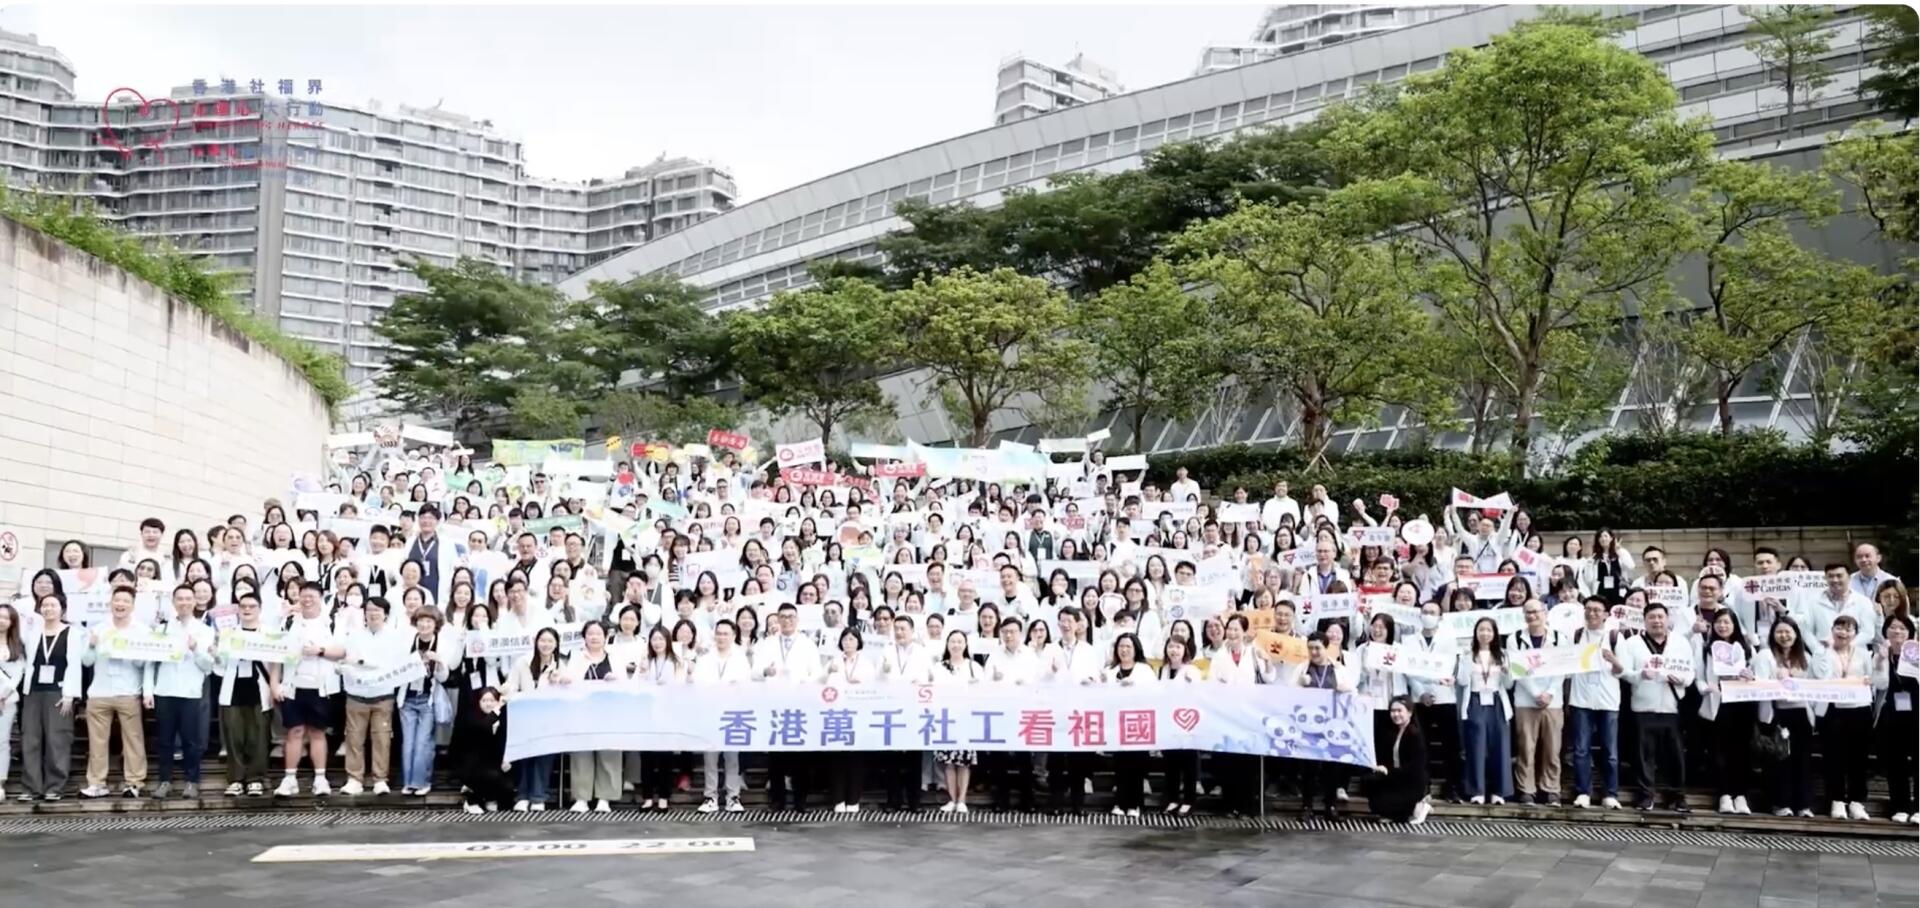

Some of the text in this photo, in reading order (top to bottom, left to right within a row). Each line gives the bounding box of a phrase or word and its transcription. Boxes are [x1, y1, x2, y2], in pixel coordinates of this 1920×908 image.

[1760, 584, 1791, 593] Caritas
[1797, 579, 1829, 589] Caritas
[719, 708, 1157, 747] 香港萬千社工看祖國
[618, 840, 736, 849] 2200
